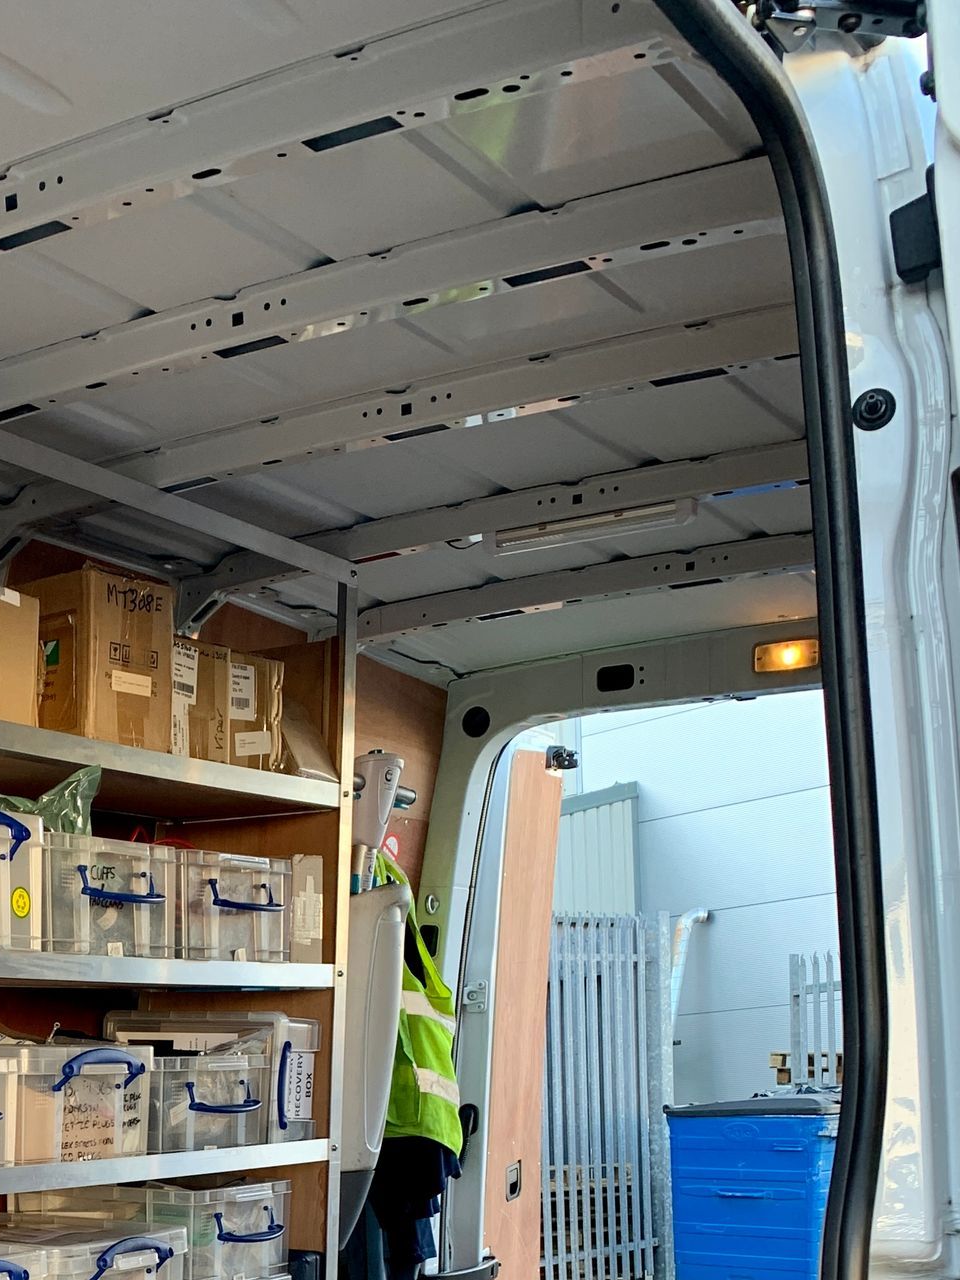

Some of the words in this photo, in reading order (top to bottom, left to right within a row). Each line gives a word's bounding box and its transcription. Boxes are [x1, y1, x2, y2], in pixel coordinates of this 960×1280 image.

[90, 864, 116, 881] CUFFS
[295, 1053, 303, 1117] RECOVERY
[305, 1072, 313, 1098] BOX
